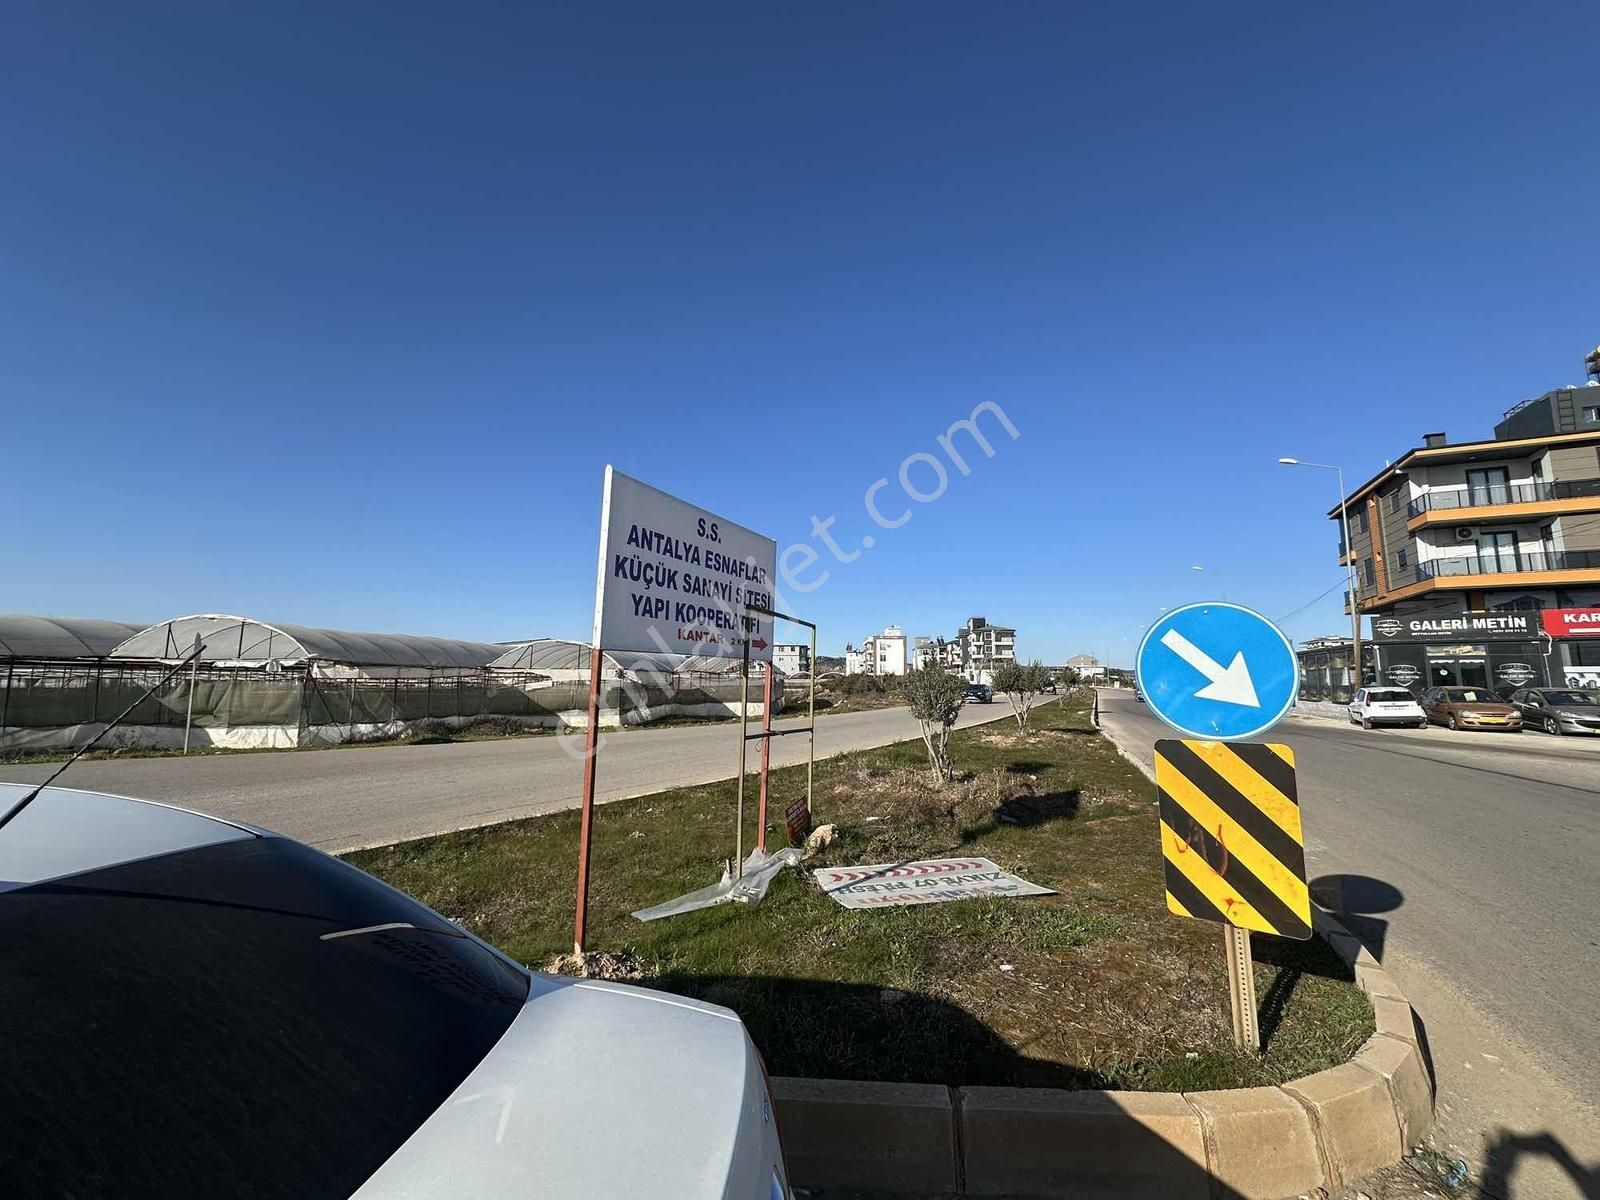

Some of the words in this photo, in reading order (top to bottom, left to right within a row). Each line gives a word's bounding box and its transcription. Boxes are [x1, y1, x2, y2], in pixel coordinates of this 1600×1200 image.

[697, 518, 722, 543] S.S.
[626, 524, 701, 566] ANTALYA
[705, 550, 766, 585] ESNAFLAR
[614, 554, 677, 590] KÜÇÜK
[683, 573, 732, 602] SANAYİ
[631, 593, 670, 621] YAPI
[1409, 616, 1468, 631] GALERİ
[1472, 614, 1527, 629] METİN
[678, 628, 724, 645] KANTAR
[731, 638, 736, 646] 2
